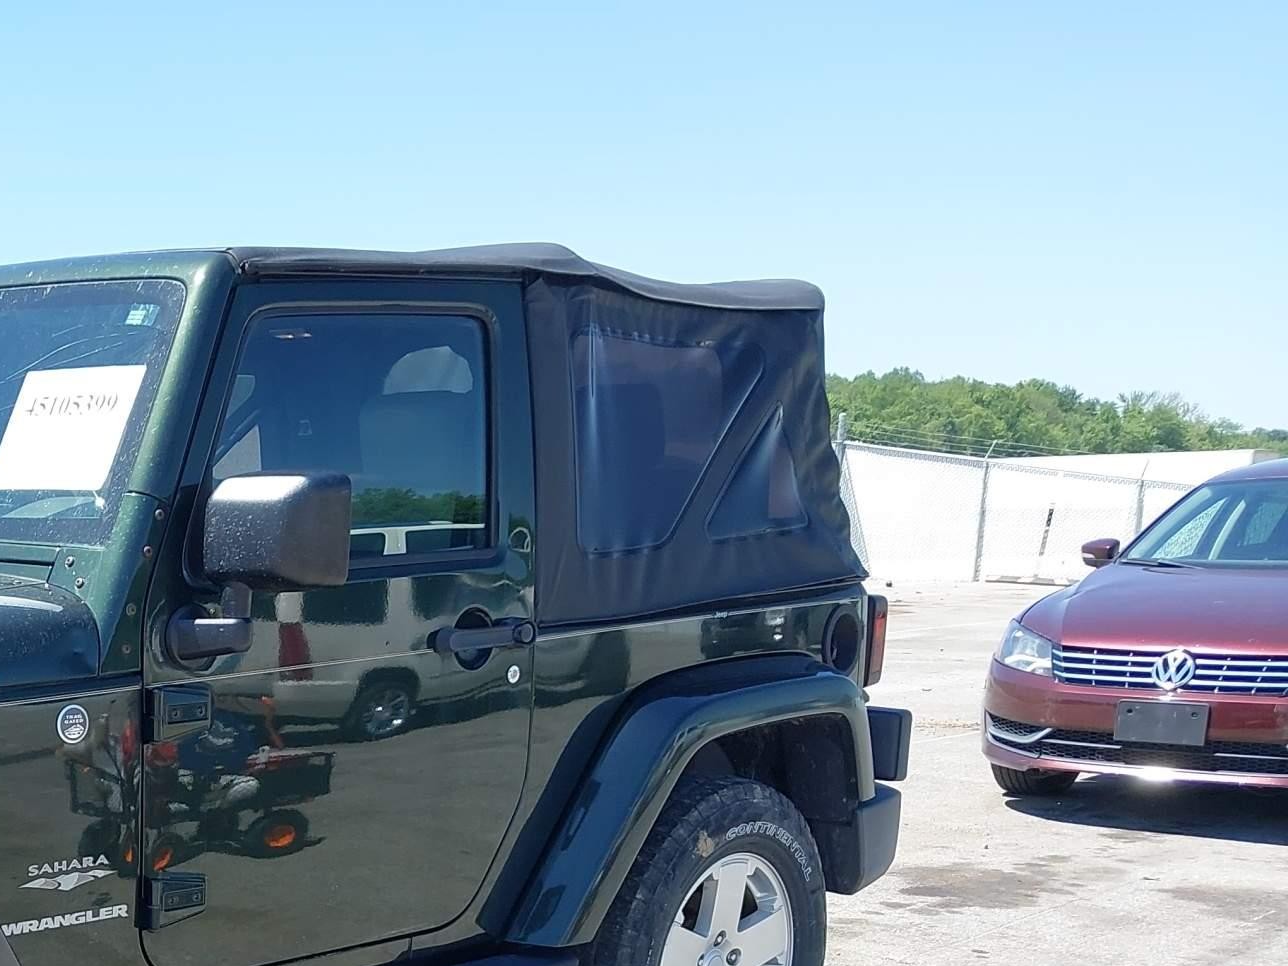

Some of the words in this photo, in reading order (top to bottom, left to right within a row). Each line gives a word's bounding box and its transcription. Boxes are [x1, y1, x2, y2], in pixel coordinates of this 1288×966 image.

[27, 854, 110, 877] SAHARA
[725, 821, 813, 882] CONTINENTAL
[1, 904, 129, 937] WRANGLER
